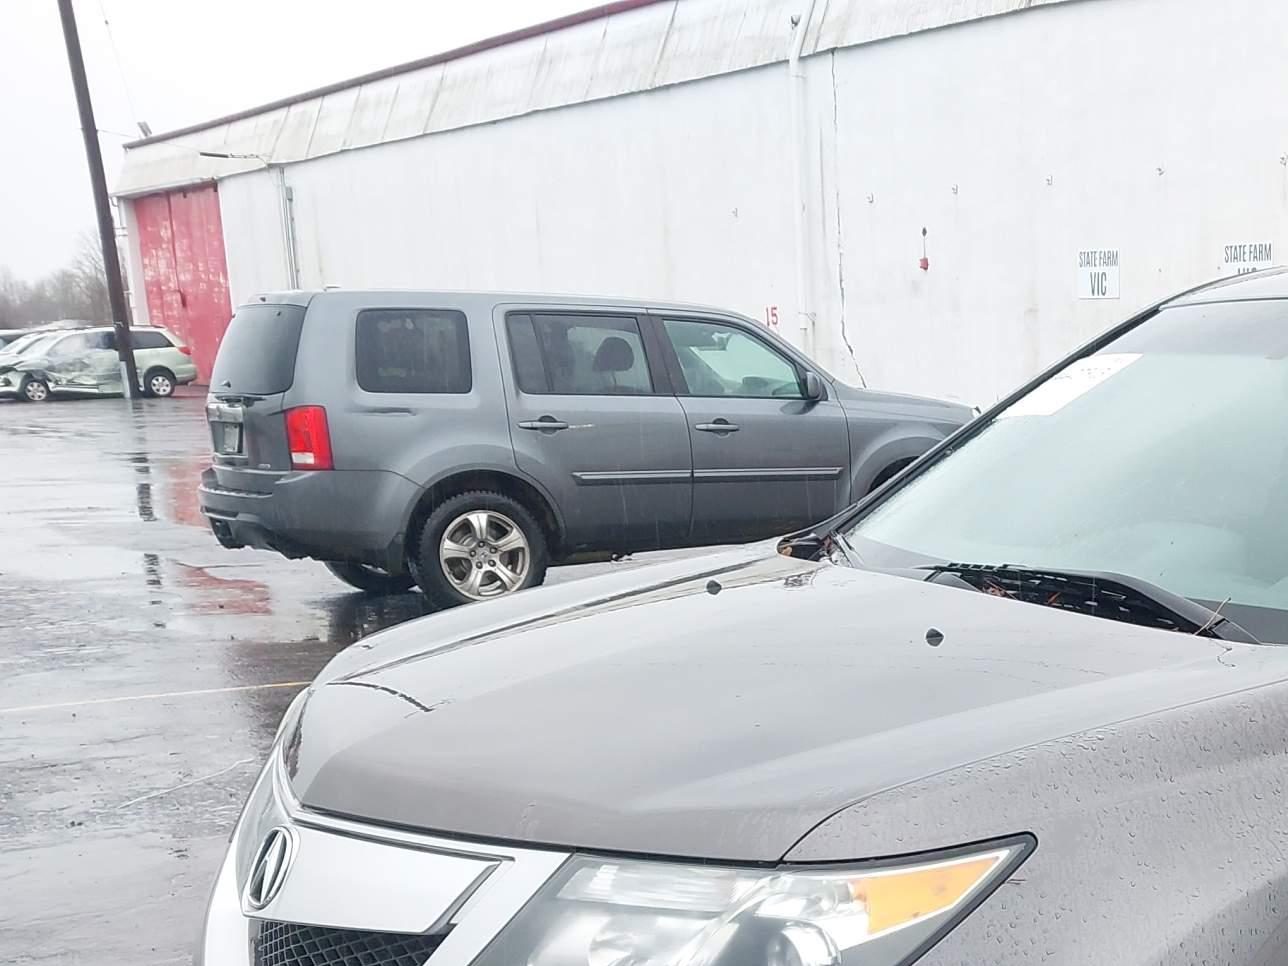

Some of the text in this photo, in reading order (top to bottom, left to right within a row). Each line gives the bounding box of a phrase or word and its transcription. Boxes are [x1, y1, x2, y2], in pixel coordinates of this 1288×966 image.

[1079, 249, 1118, 268] STATE FARM
[1224, 242, 1272, 263] STATE FARM
[1089, 271, 1107, 297] VIC
[766, 306, 779, 327] 15
